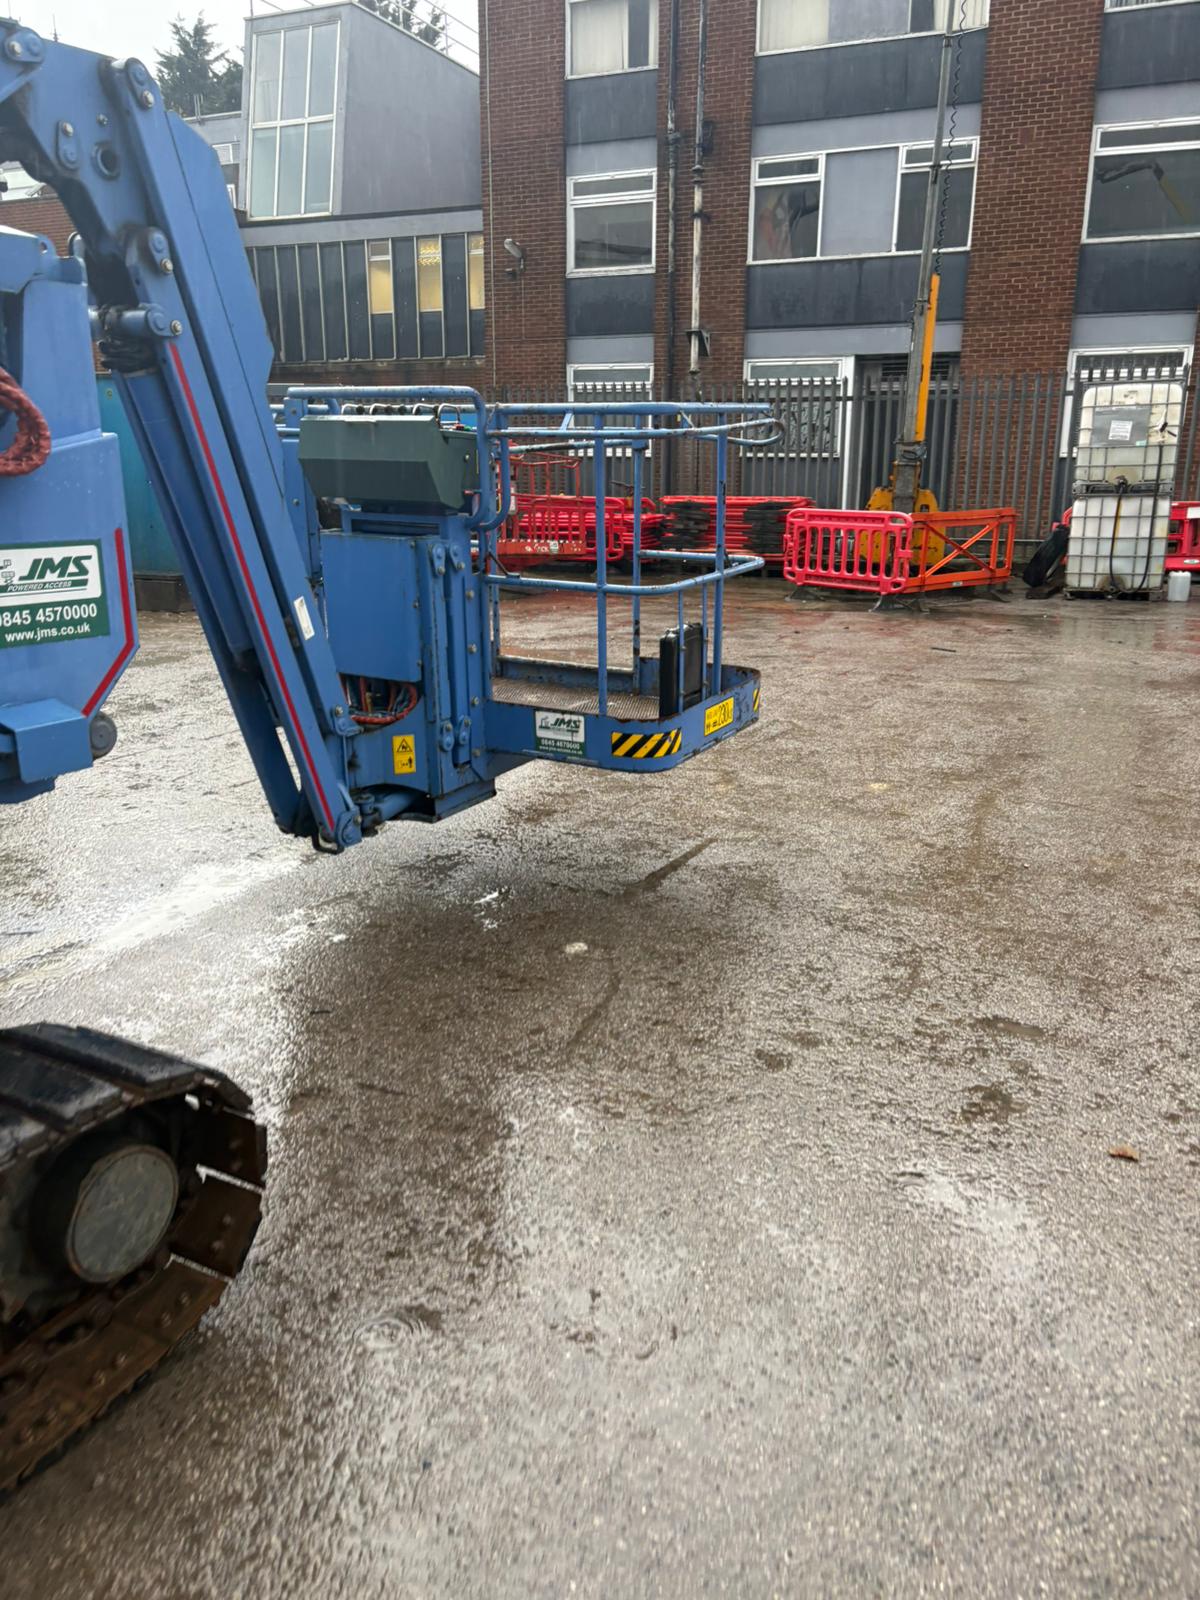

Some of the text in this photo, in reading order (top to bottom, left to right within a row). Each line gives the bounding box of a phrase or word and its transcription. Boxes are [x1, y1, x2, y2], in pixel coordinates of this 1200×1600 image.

[18, 555, 92, 581] JMS
[7, 581, 72, 592] POWERED ACCESS
[0, 603, 97, 627] 845 4570000
[5, 622, 91, 642] www.jms.co.uk
[550, 718, 582, 729] JMS
